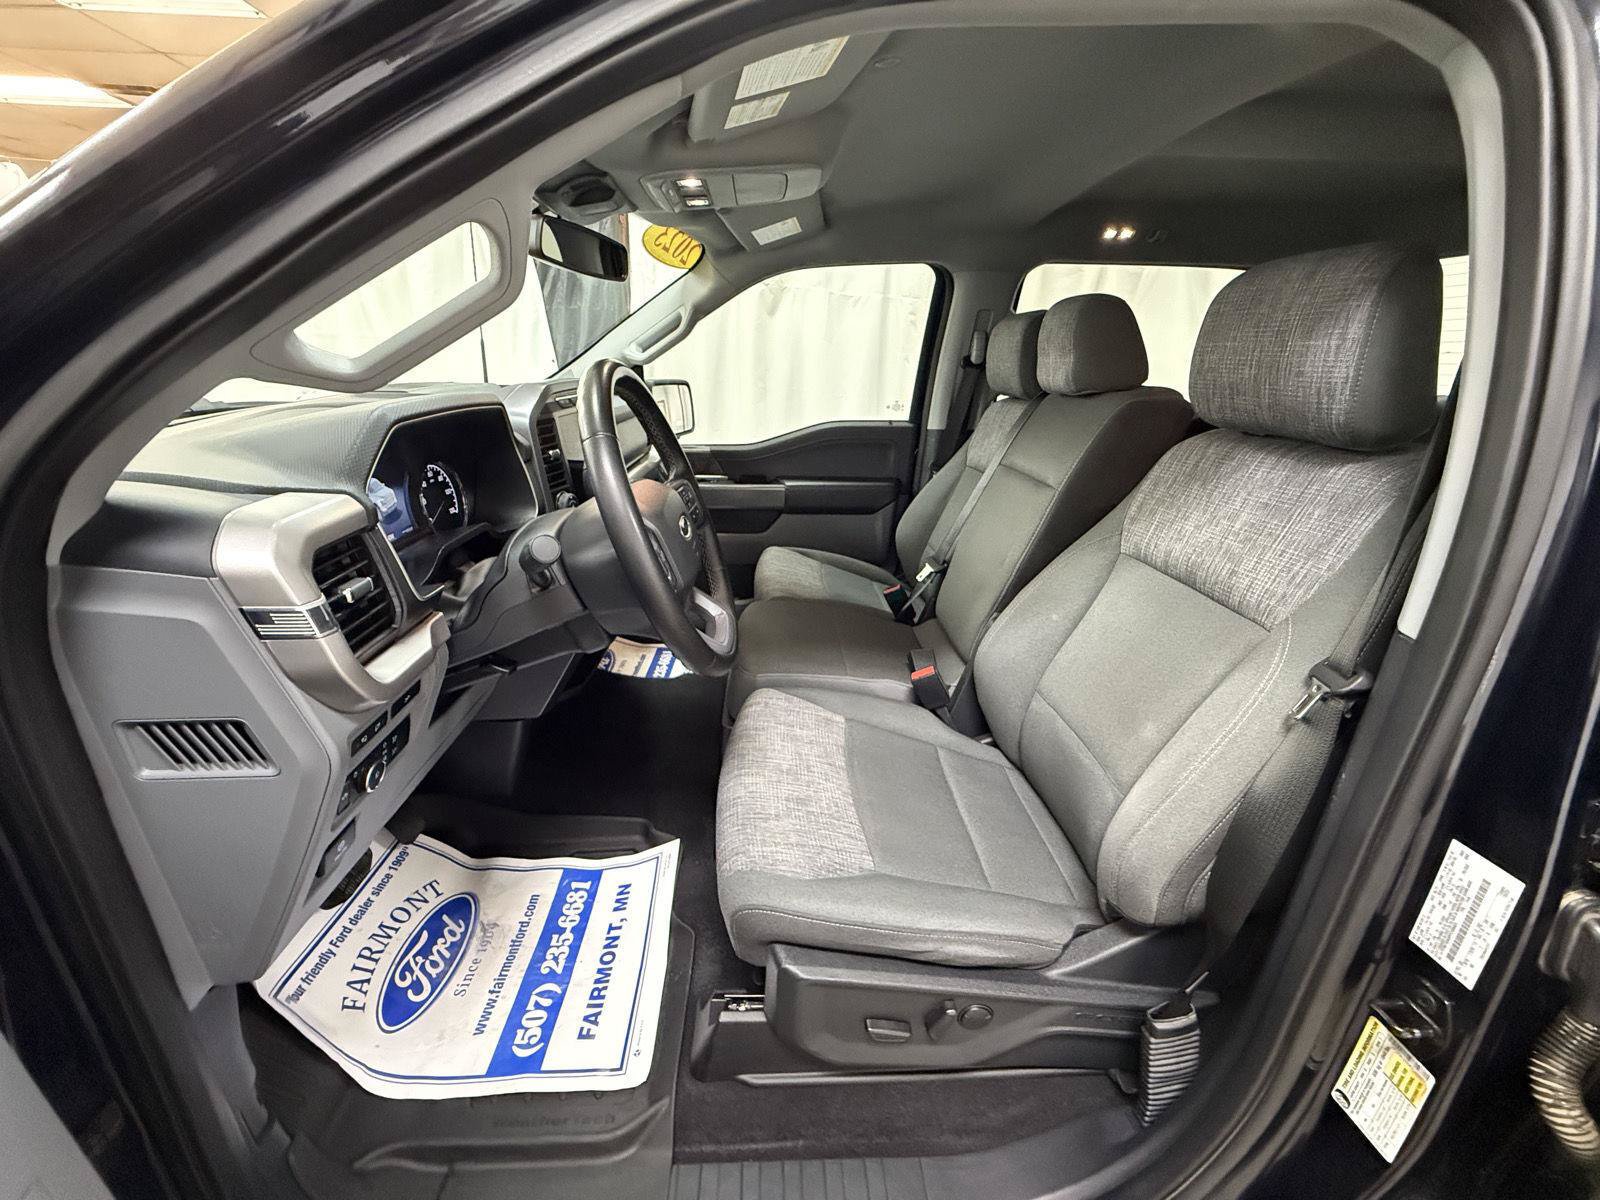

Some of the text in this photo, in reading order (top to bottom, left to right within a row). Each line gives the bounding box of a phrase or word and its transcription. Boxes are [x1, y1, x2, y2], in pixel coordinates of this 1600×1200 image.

[301, 948, 336, 987] friendly
[329, 924, 352, 949] Ford
[349, 897, 375, 926] dealer
[371, 873, 393, 897] since
[341, 879, 444, 1013] FAIRMONT
[394, 914, 466, 1003] Ford
[453, 957, 482, 998] Since
[473, 893, 541, 1036] www.fairmontford.com
[512, 982, 562, 1058] (507)
[540, 880, 593, 975] 235-6681
[577, 883, 633, 1040] FAIRMONT, MN
